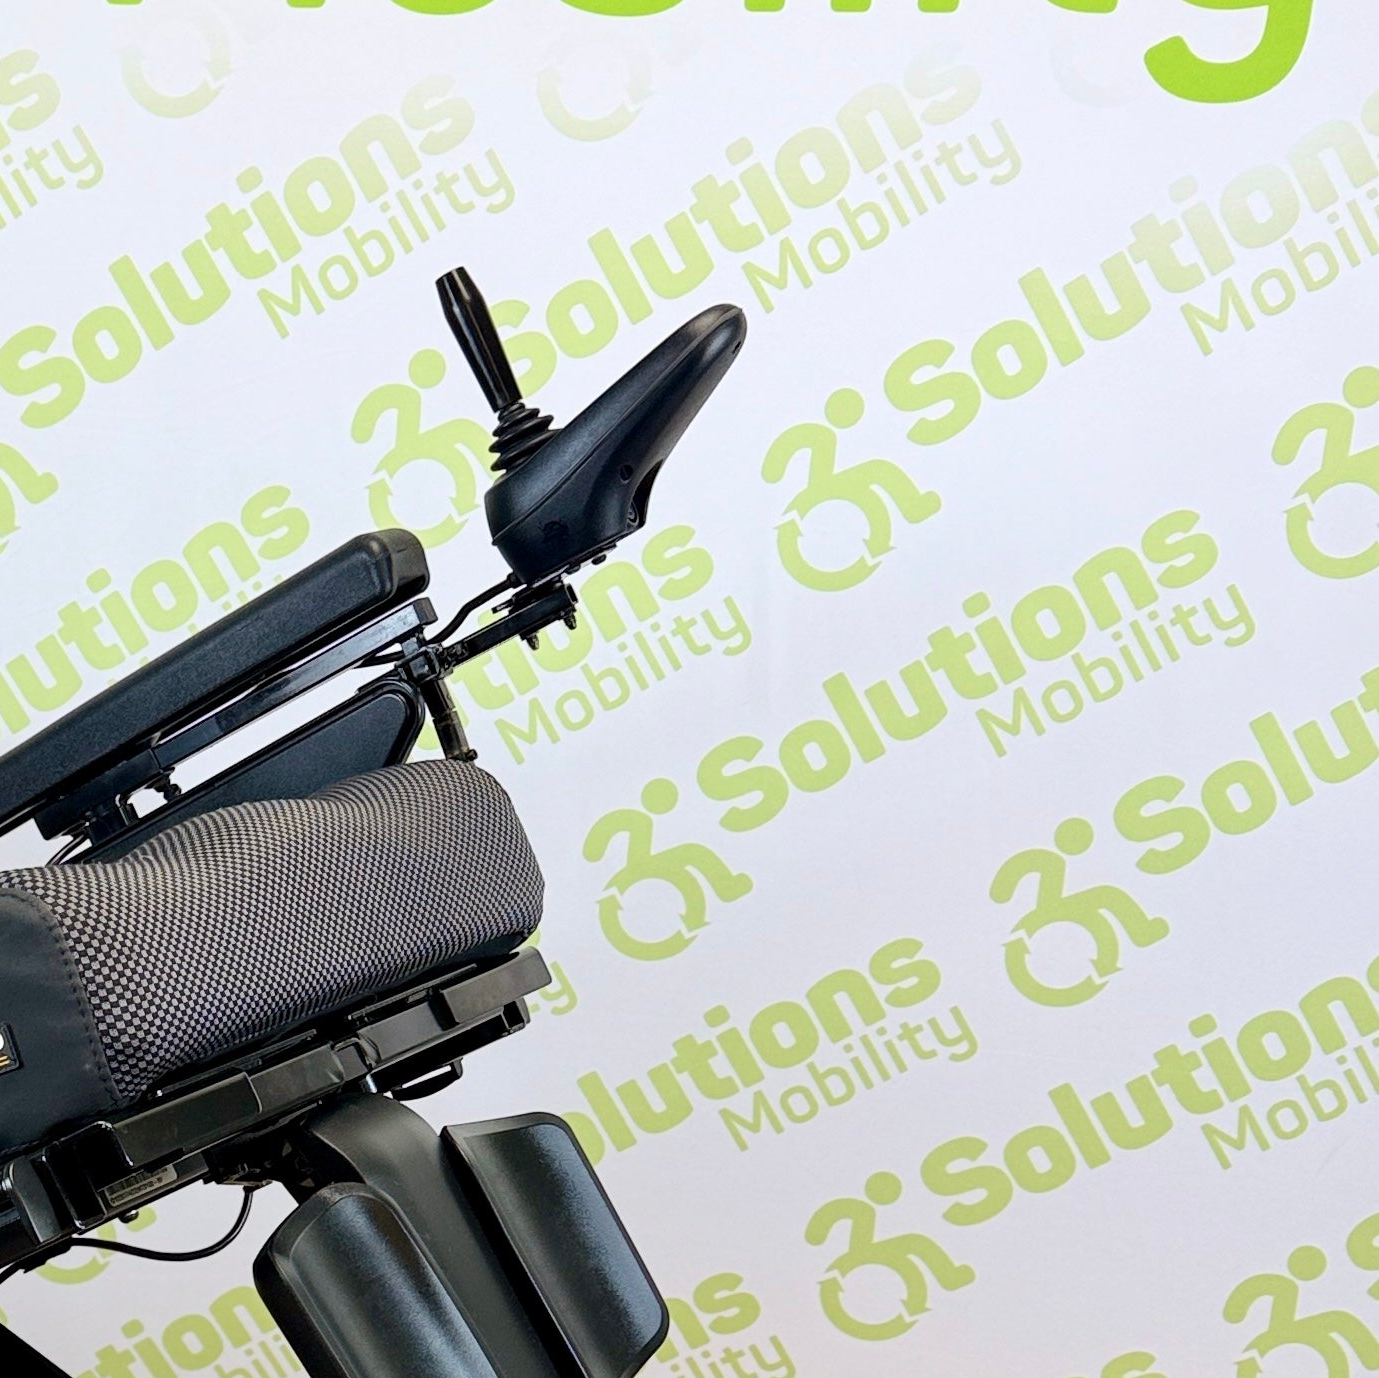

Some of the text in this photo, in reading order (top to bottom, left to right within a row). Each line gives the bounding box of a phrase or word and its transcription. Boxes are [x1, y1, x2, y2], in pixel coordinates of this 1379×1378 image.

[256, 147, 516, 339] Mobility
[741, 118, 1022, 314] Mobility
[883, 86, 1379, 446] Solution
[1180, 186, 1379, 357] Mobil
[494, 595, 752, 765] Mobility
[697, 510, 1219, 832] Solutions
[977, 583, 1256, 758] Mobility
[719, 1006, 979, 1152] Mobility
[921, 973, 1379, 1226] Solution
